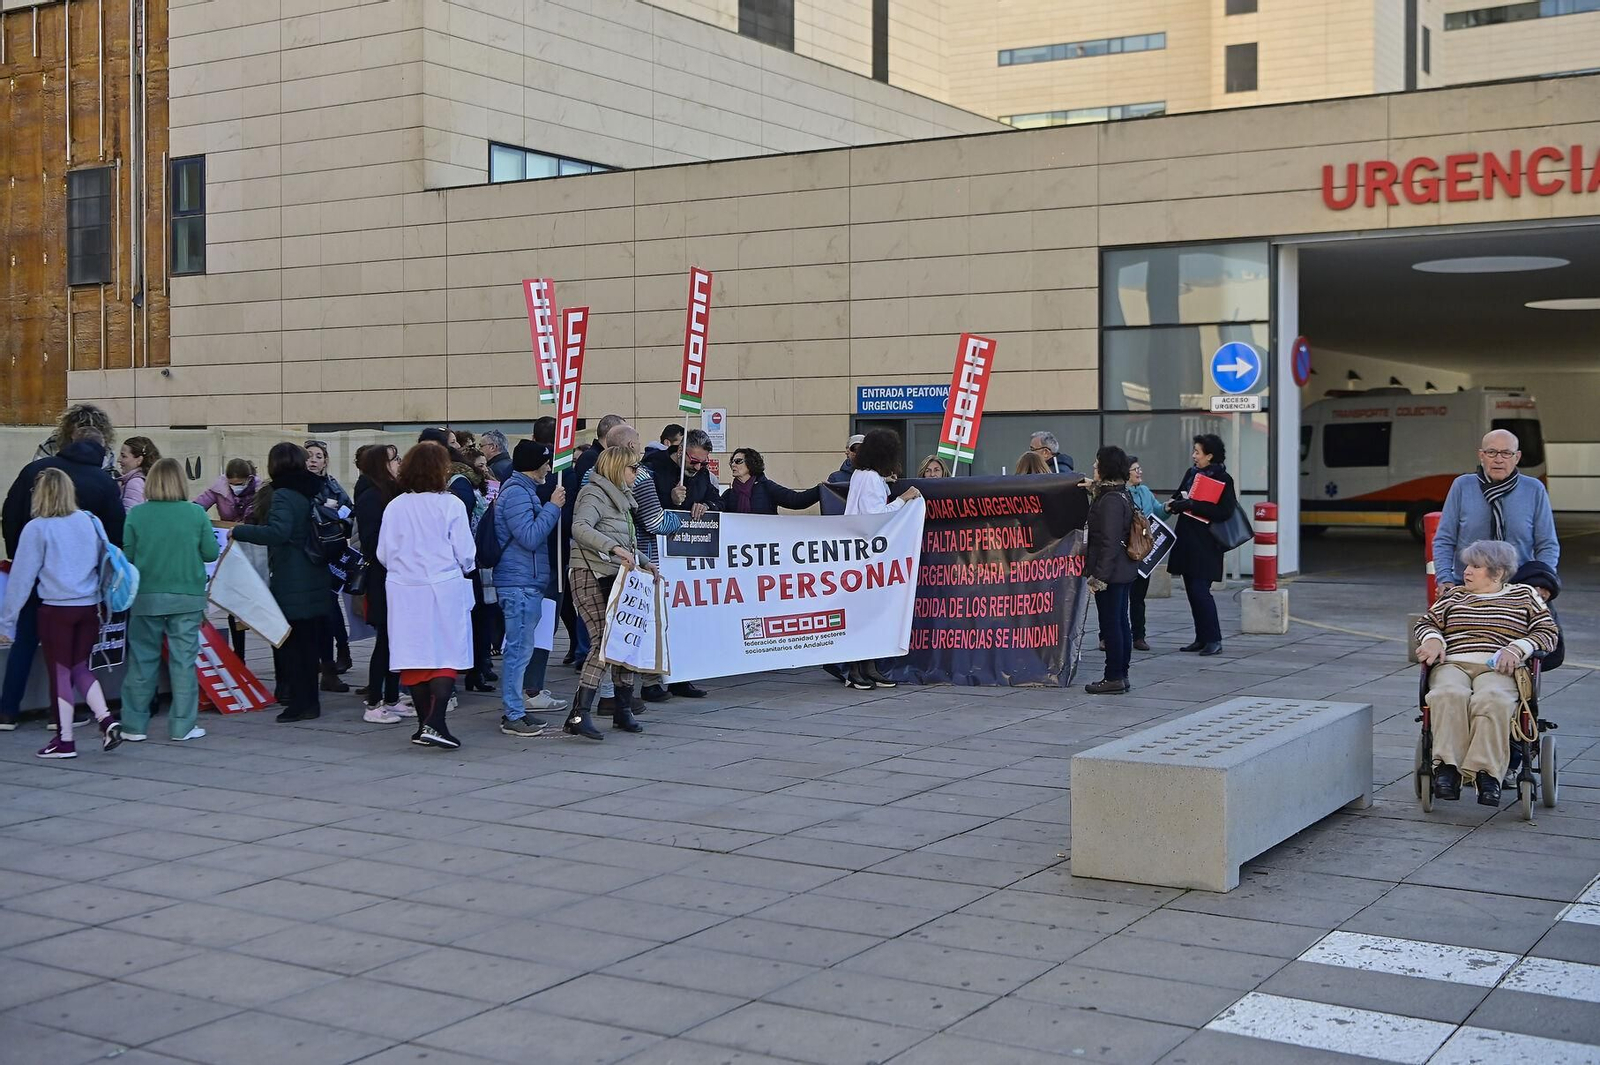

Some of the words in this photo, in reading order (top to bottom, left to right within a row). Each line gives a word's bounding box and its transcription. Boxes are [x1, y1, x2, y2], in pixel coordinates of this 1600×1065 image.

[1322, 145, 1600, 210] URGENCI
[529, 282, 560, 387] CCOO
[685, 272, 709, 394] CCOO
[559, 311, 583, 449] CCOO
[862, 388, 904, 398] ENTRADA
[906, 386, 950, 397] PEATONA
[948, 337, 989, 445] CCOO
[862, 400, 914, 411] URGENCIAS
[1332, 408, 1390, 419] TRANSPORTE
[1395, 406, 1448, 418] COLECTIVO
[956, 497, 979, 518] LAS
[977, 495, 1043, 517] URGENCIAS!
[727, 542, 780, 568] ESTE
[792, 536, 888, 565] CENTRO
[926, 529, 957, 553] FALTA
[959, 528, 973, 552] DE
[975, 526, 1034, 551] PERSONAL!
[977, 562, 1005, 585] PARA
[1009, 555, 1085, 583] ENDOSCOPIAS!
[948, 597, 966, 618] DE
[966, 595, 987, 618] LOS
[989, 591, 1054, 617] REFUERZOS!
[768, 615, 827, 634] CCOO
[931, 628, 993, 650] URGENCIAS
[995, 628, 1010, 649] SE
[1011, 624, 1059, 649] HUNDAN!
[744, 638, 777, 647] federación
[787, 635, 814, 644] sanidad
[820, 631, 846, 640] sectores
[745, 645, 793, 655] sociosanitarios
[793, 643, 802, 651] de
[803, 640, 834, 650] Andalucía
